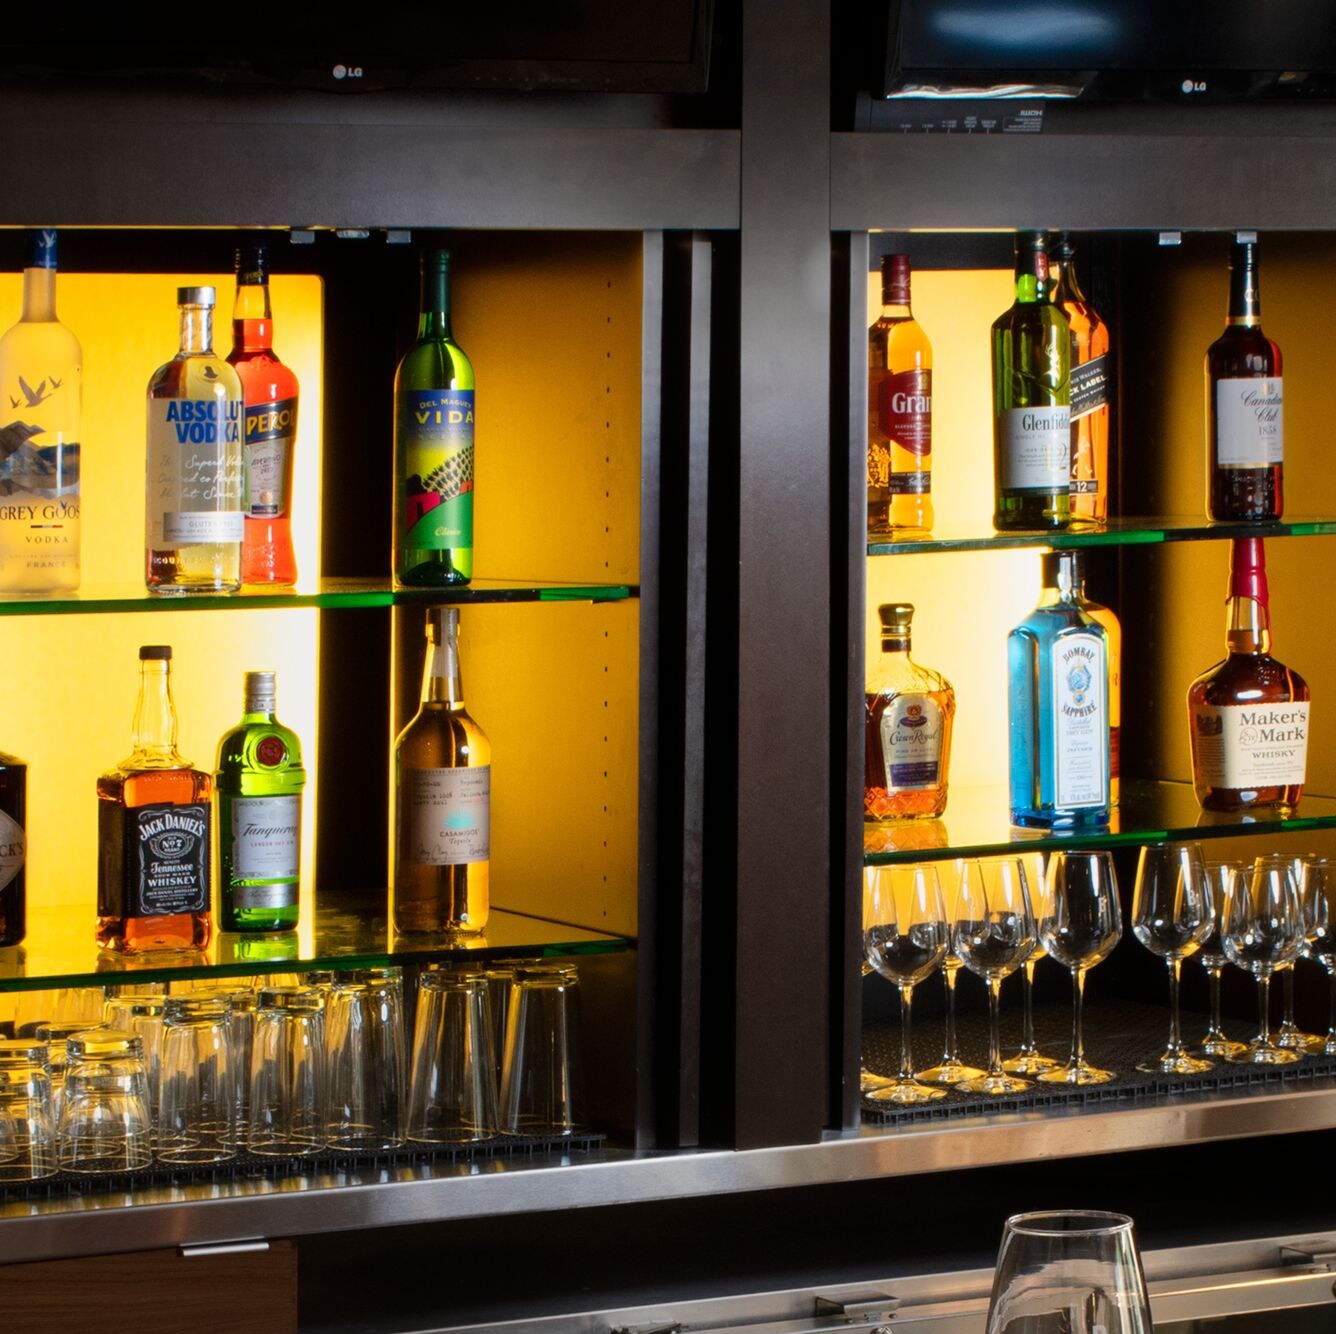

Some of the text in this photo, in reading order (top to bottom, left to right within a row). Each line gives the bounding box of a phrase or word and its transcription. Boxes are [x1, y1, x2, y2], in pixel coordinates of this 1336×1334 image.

[348, 67, 362, 77] LG
[1194, 82, 1206, 91] LG
[1080, 375, 1106, 391] LABEL
[415, 410, 474, 425] VIDA
[175, 422, 239, 444] VODKA
[1076, 481, 1088, 493] 12
[0, 505, 37, 520] GREY
[25, 536, 69, 544] VODKA
[1062, 646, 1096, 664] BOMBAY
[1061, 702, 1098, 718] SAPPHIRE
[1239, 710, 1307, 727] Maker's
[1260, 727, 1306, 743] Mark
[1252, 750, 1296, 760] WHISKY
[138, 813, 206, 841] JACK DANIEL'S
[150, 862, 194, 874] Tennessee
[147, 876, 197, 888] WHISKEY
